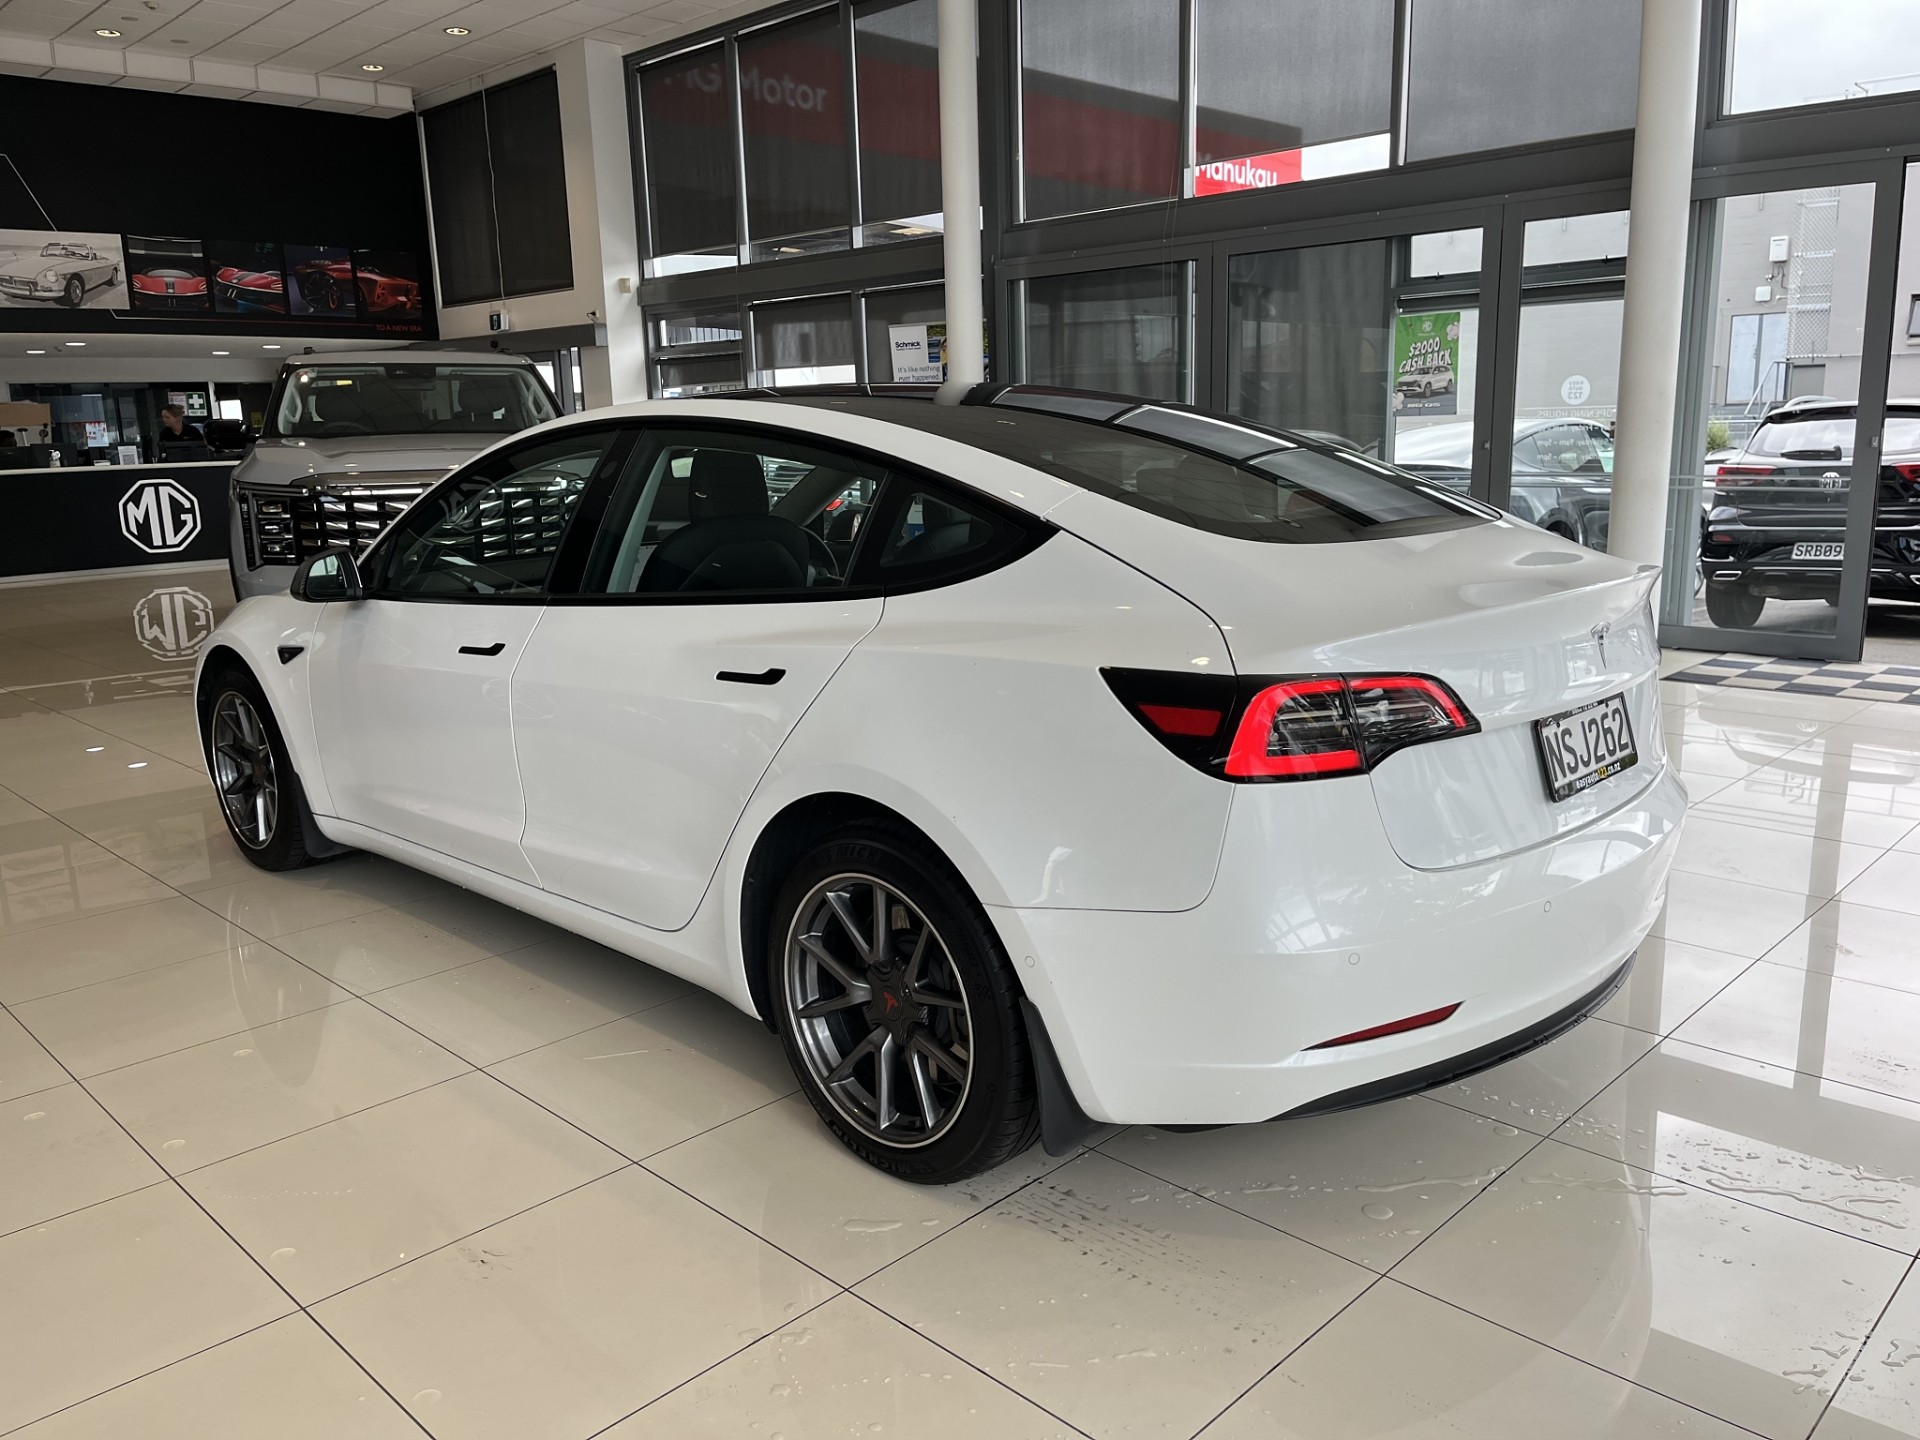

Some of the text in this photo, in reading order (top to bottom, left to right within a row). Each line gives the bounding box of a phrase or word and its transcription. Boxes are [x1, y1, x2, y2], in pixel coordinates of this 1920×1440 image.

[742, 67, 827, 111] Motor
[1196, 156, 1277, 188] Manukau
[1399, 348, 1452, 373] CASH BACK
[1409, 337, 1440, 357] $2000
[919, 365, 941, 373] nothing
[126, 485, 194, 547] MG
[1794, 544, 1843, 557] SRB09
[1545, 706, 1630, 783] NSJ262
